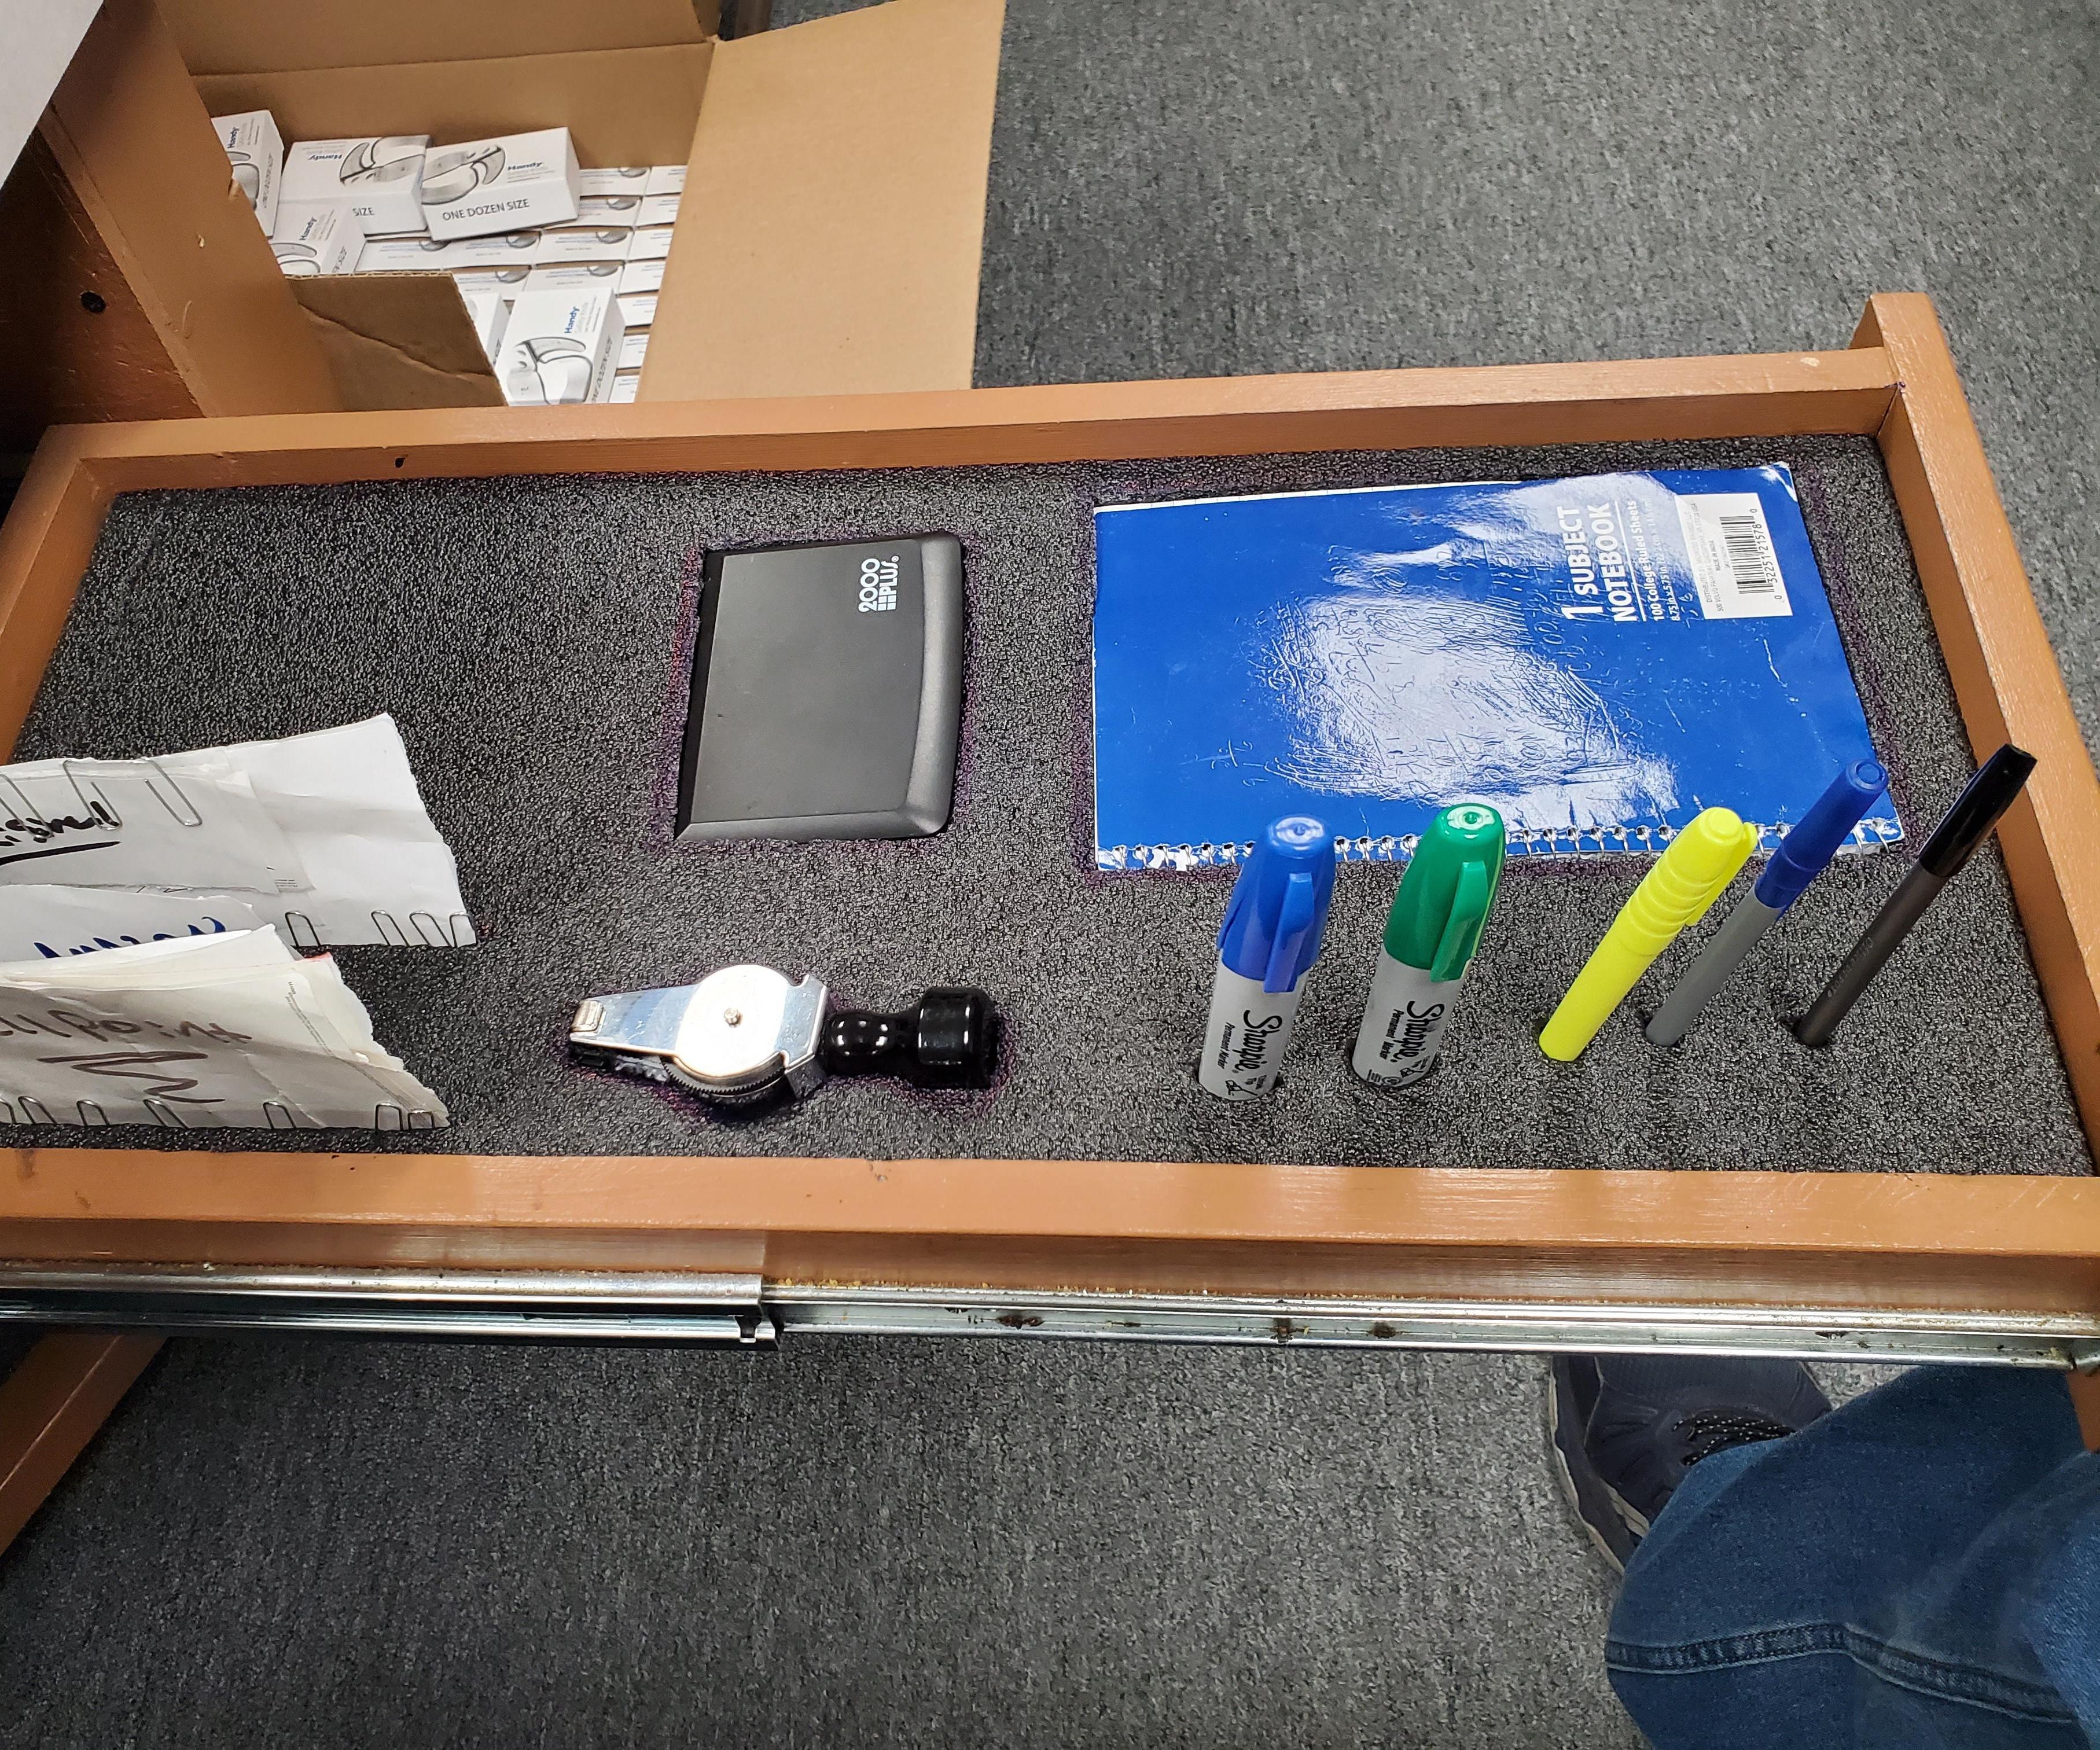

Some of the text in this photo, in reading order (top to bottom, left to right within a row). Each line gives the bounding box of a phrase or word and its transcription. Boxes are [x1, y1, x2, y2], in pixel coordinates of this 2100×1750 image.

[507, 161, 543, 171] Handy
[352, 207, 375, 216] SIZE
[442, 198, 530, 221] ONE DOZEN SIZE
[564, 306, 580, 334] Handy
[1752, 524, 1768, 552] 21578
[1557, 506, 1603, 620] 1 SUBJECT
[1587, 502, 1638, 622] NOTEBOOK
[1627, 500, 1665, 622] 100 College Ruled Sheets
[1712, 558, 1721, 571] MADE
[1761, 556, 1778, 583] 32251
[859, 558, 880, 612] 2000
[1661, 575, 1672, 591] 5.75
[1711, 587, 1721, 602] VOLVO
[1668, 603, 1680, 622] 8.75
[1715, 603, 1724, 611] 500
[1385, 1009, 1405, 1039] Permanent
[1392, 1001, 1445, 1060] Sharpie
[1218, 1021, 1236, 1069] Permanent Marker
[1232, 1009, 1283, 1071] Sharpie
[1379, 1041, 1395, 1060] Marker
